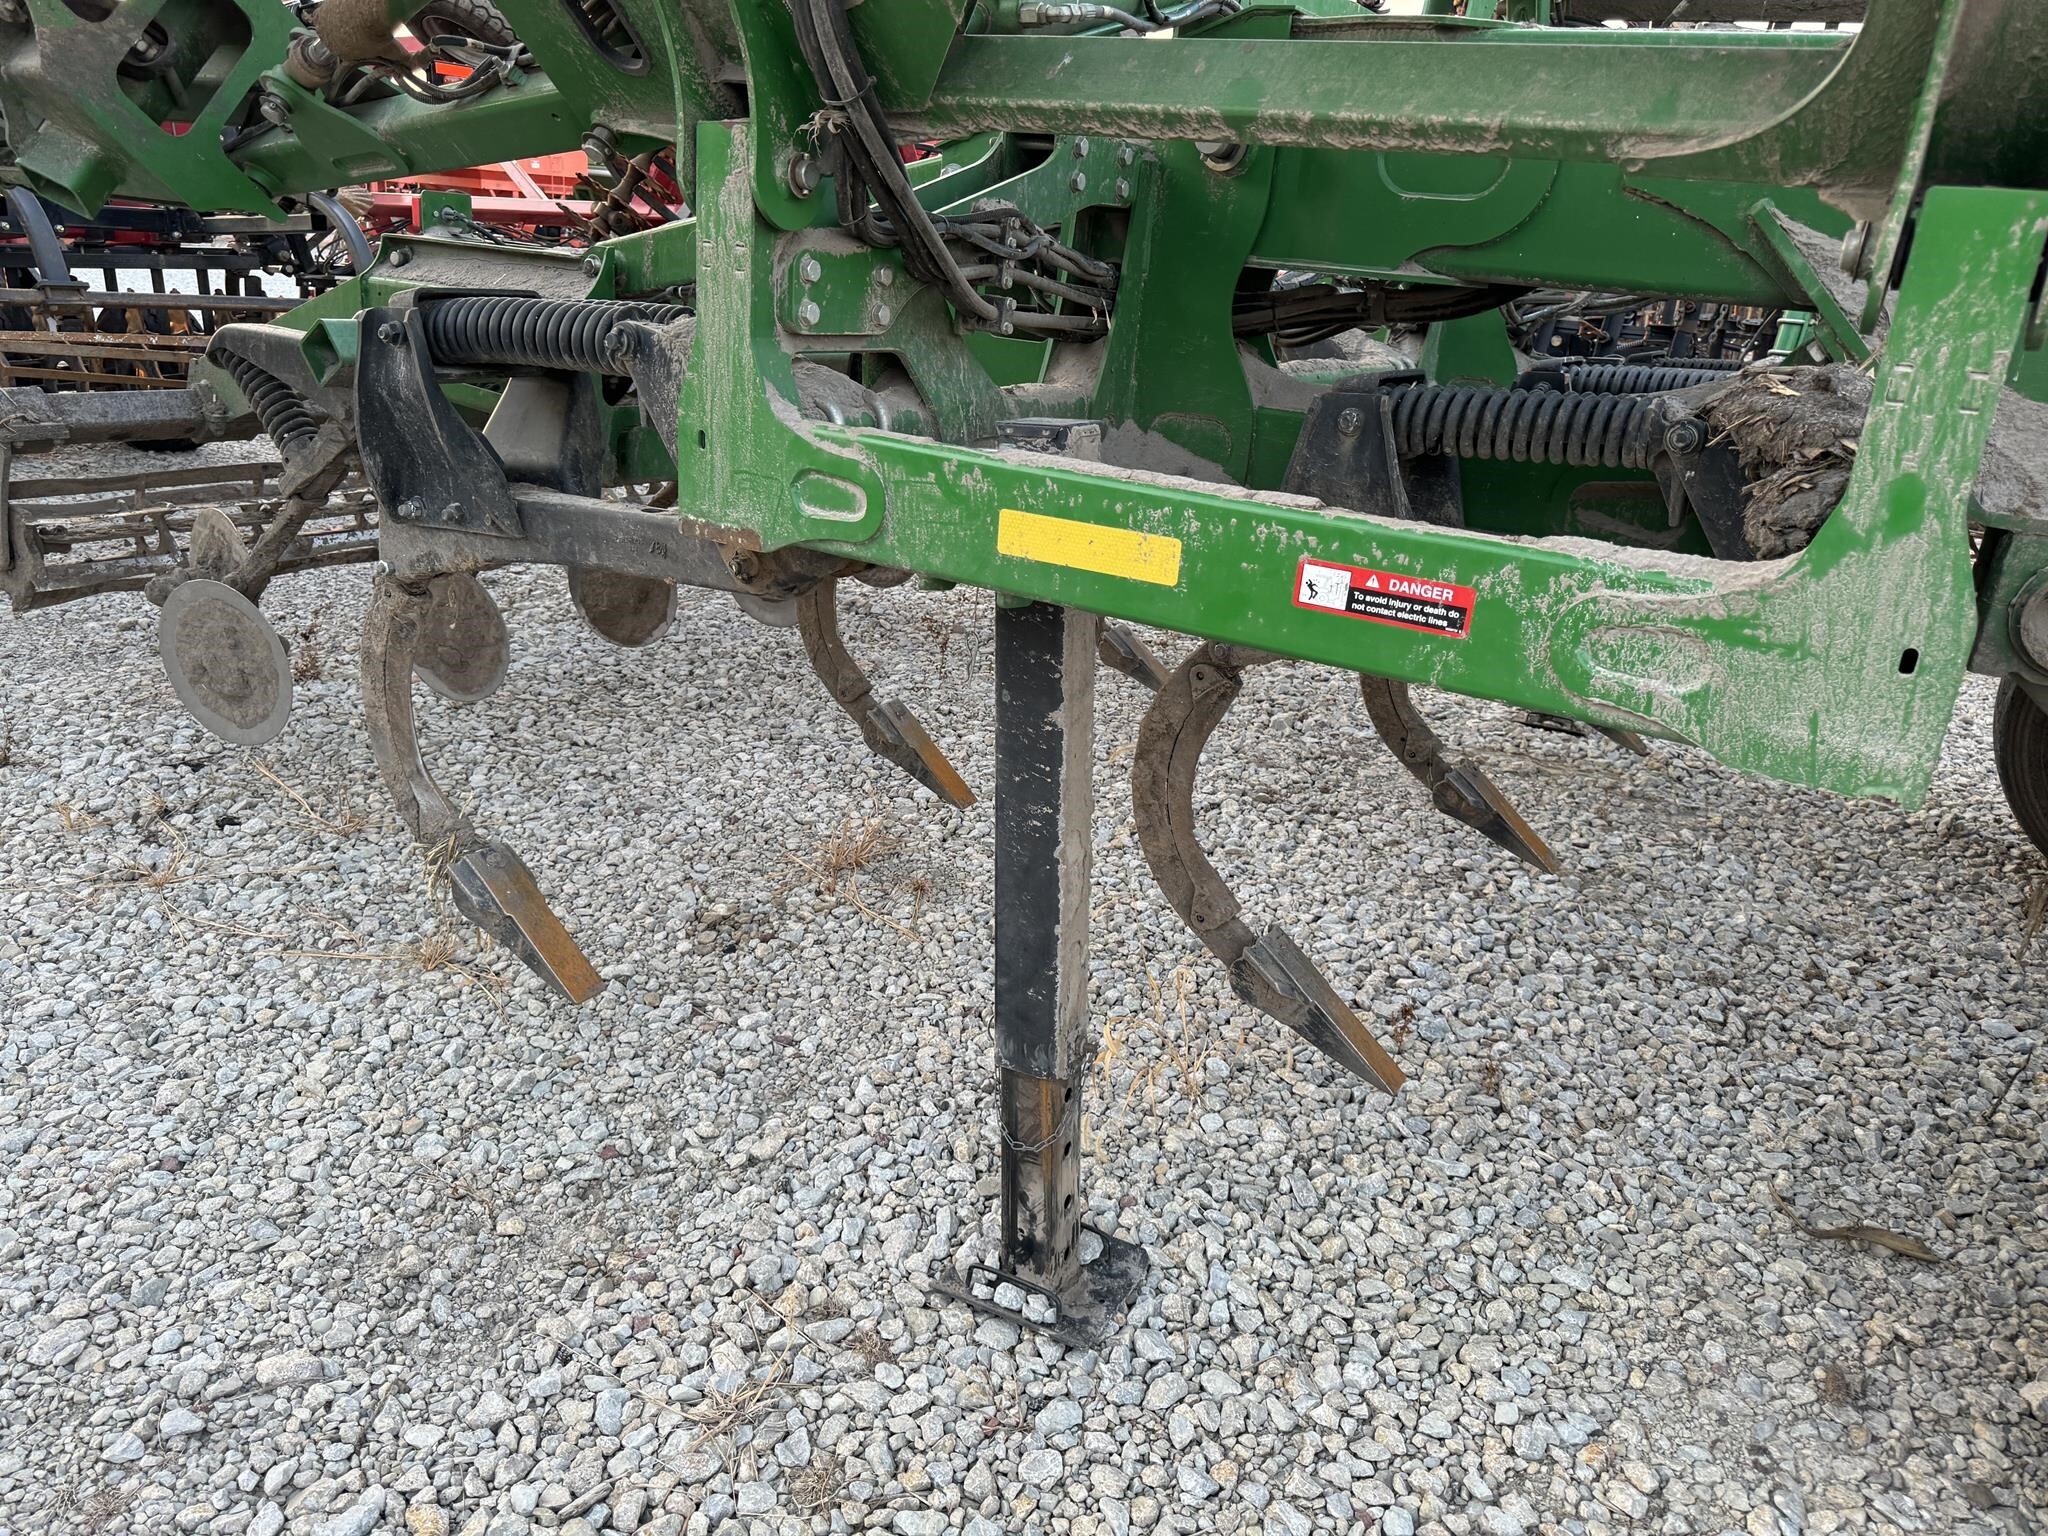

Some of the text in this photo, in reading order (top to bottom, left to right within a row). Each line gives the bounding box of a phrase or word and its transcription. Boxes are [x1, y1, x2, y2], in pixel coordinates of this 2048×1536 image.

[1389, 579, 1454, 601] DANGER
[1351, 602, 1448, 627] not contact electric lines
[1353, 591, 1460, 619] To avoid injury or death do
